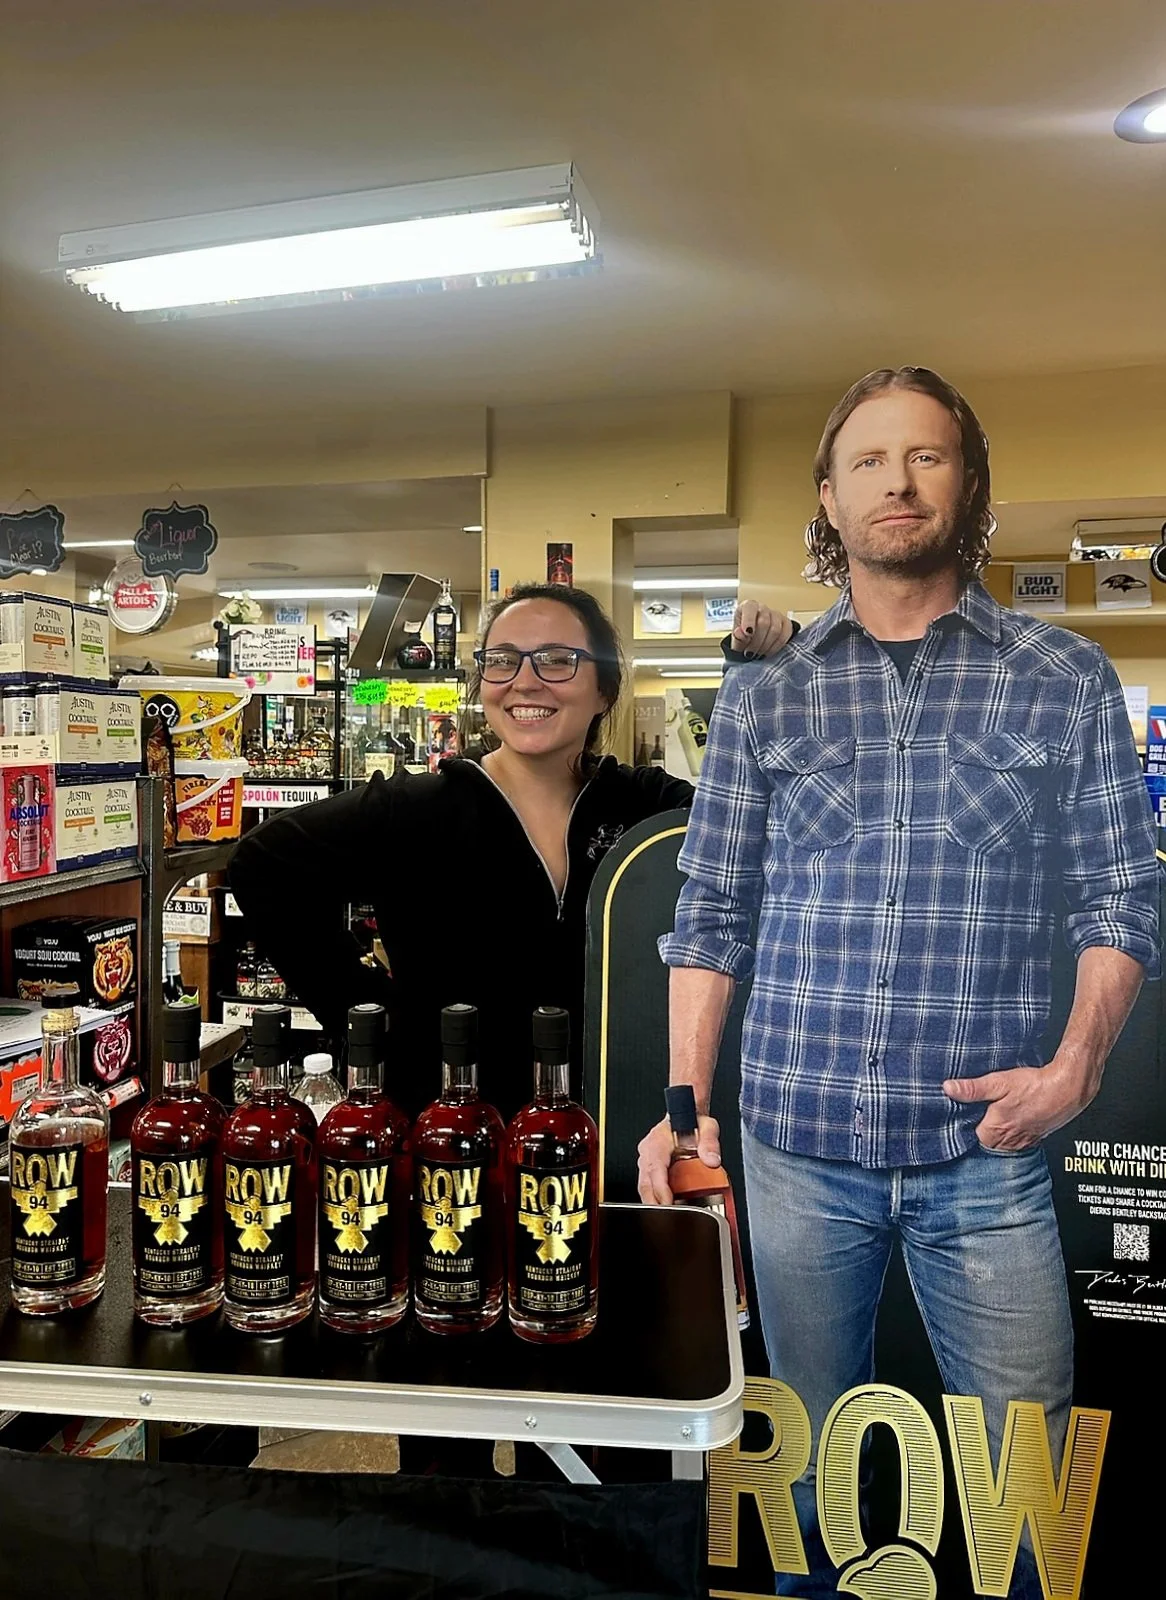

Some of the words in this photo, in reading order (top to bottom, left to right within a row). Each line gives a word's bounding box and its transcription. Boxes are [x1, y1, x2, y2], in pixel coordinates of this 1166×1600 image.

[1023, 576, 1054, 586] BUD
[1018, 586, 1060, 595] LIGHT
[117, 597, 151, 605] ARTOIS
[36, 606, 61, 622] AUSTIN
[34, 622, 65, 635] COCKTAILS
[82, 618, 102, 632] AUSTIN
[81, 633, 104, 644] COCKTAILS
[70, 696, 95, 710] AUSTIN
[109, 702, 132, 715] AUSTIN
[68, 713, 97, 724] COCKTAILS
[107, 718, 134, 728] COCKTAILS
[67, 790, 92, 805] AUSTIN
[105, 788, 128, 802] AUSTIN
[281, 791, 319, 802] TEQUILA
[10, 804, 49, 822] ABSOLUT
[65, 806, 95, 818] COCKTAILS
[104, 803, 131, 814] COCKTAILS
[174, 901, 183, 912] &
[184, 902, 208, 914] BUY
[14, 949, 37, 960] YOGURT
[37, 950, 52, 961] SOJU
[52, 951, 82, 962] COCKTAIL
[1074, 1140, 1110, 1158] YOUR
[1113, 1143, 1166, 1162] CHANCE
[11, 1150, 78, 1188] ROW
[1064, 1156, 1107, 1175] DRINK
[1109, 1160, 1146, 1178] WITH
[139, 1158, 208, 1197] ROW
[225, 1164, 292, 1204] ROW
[323, 1164, 389, 1205] ROW
[419, 1165, 481, 1205] ROW
[520, 1171, 588, 1213] ROW
[1077, 1184, 1094, 1193] SCAN
[1094, 1185, 1107, 1194] FOR
[1107, 1187, 1112, 1195] A
[1112, 1186, 1136, 1197] CHANCE
[1137, 1188, 1145, 1197] TO
[1145, 1189, 1158, 1198] WIN
[29, 1196, 49, 1210] 94
[1077, 1194, 1102, 1204] TICKETS
[1102, 1197, 1115, 1206] AND
[1115, 1198, 1135, 1207] SHARE
[160, 1204, 181, 1218] 94
[244, 1210, 263, 1225] 94
[1089, 1206, 1111, 1216] DIERKS
[1112, 1208, 1137, 1218] BENTLEY
[341, 1212, 361, 1226] 94
[435, 1212, 454, 1227] 94
[543, 1221, 564, 1235] 94
[708, 1376, 1112, 1600] ROW
